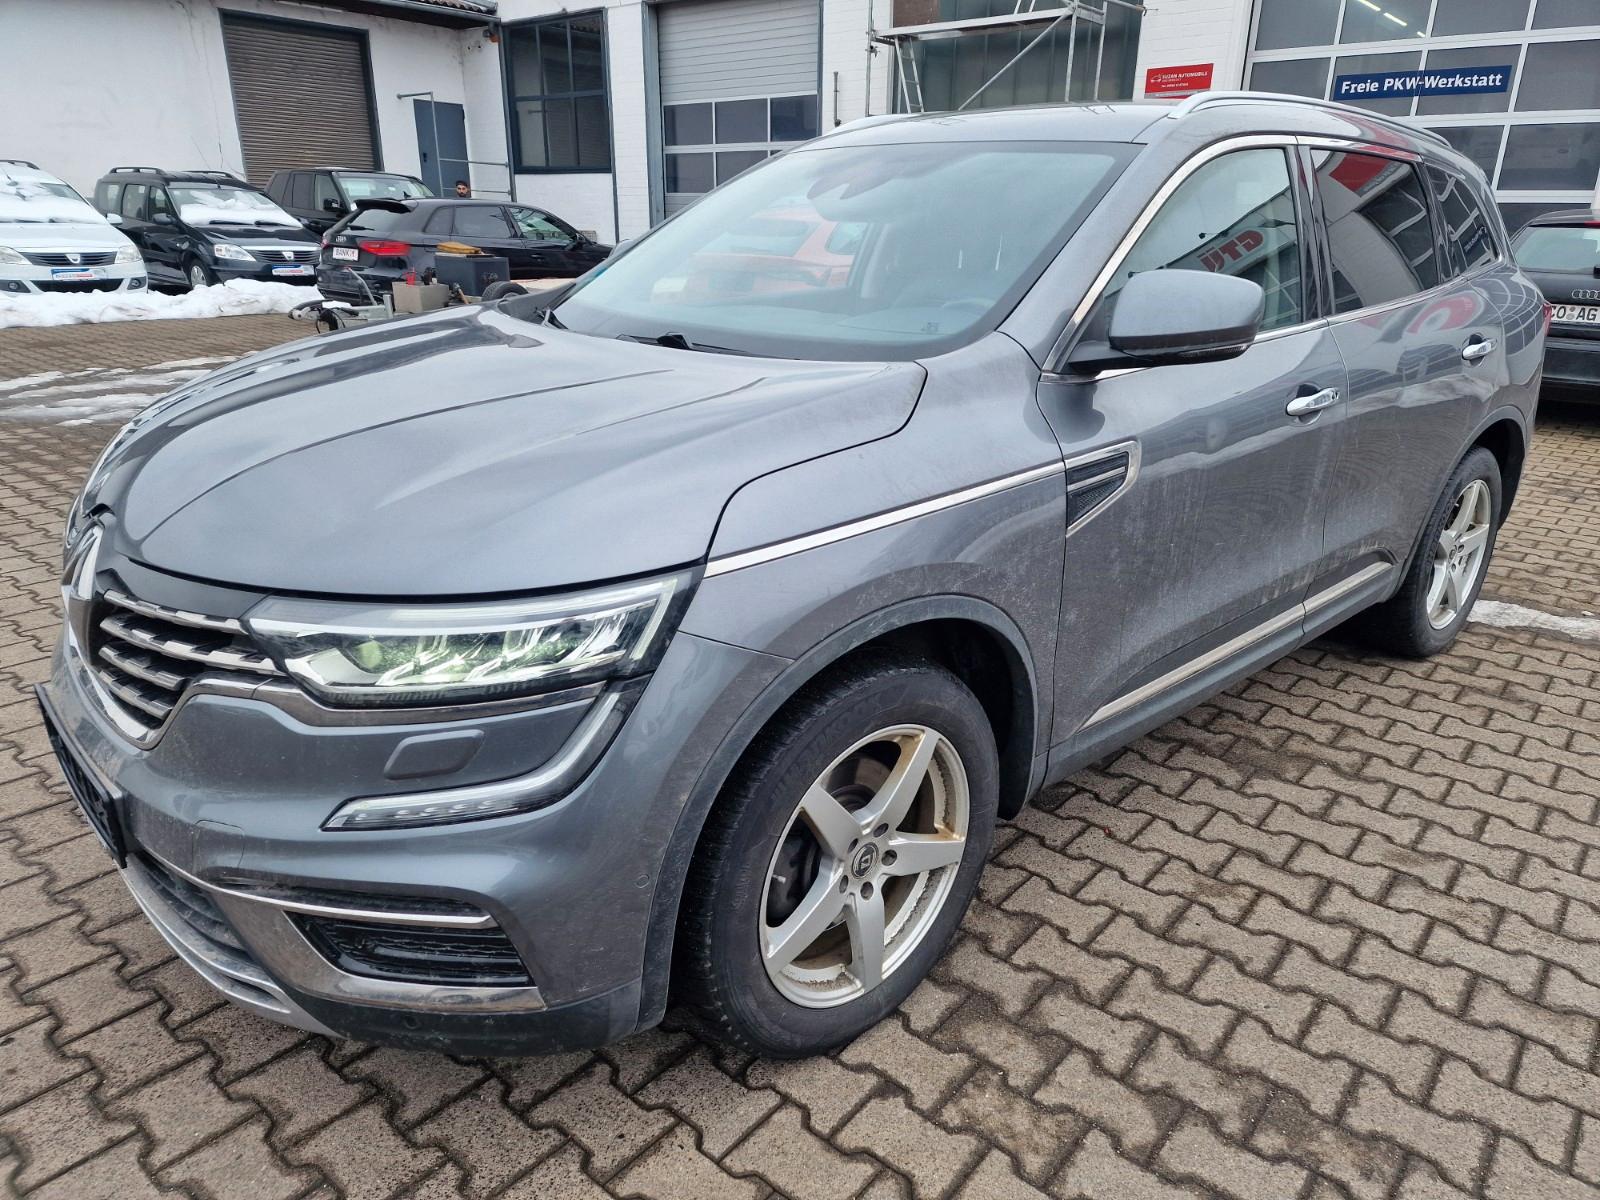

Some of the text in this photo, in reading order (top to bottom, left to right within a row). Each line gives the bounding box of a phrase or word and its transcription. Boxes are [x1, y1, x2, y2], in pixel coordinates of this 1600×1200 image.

[1341, 73, 1503, 94] Freie PKW-Werkstatt
[1576, 307, 1598, 321] AG
